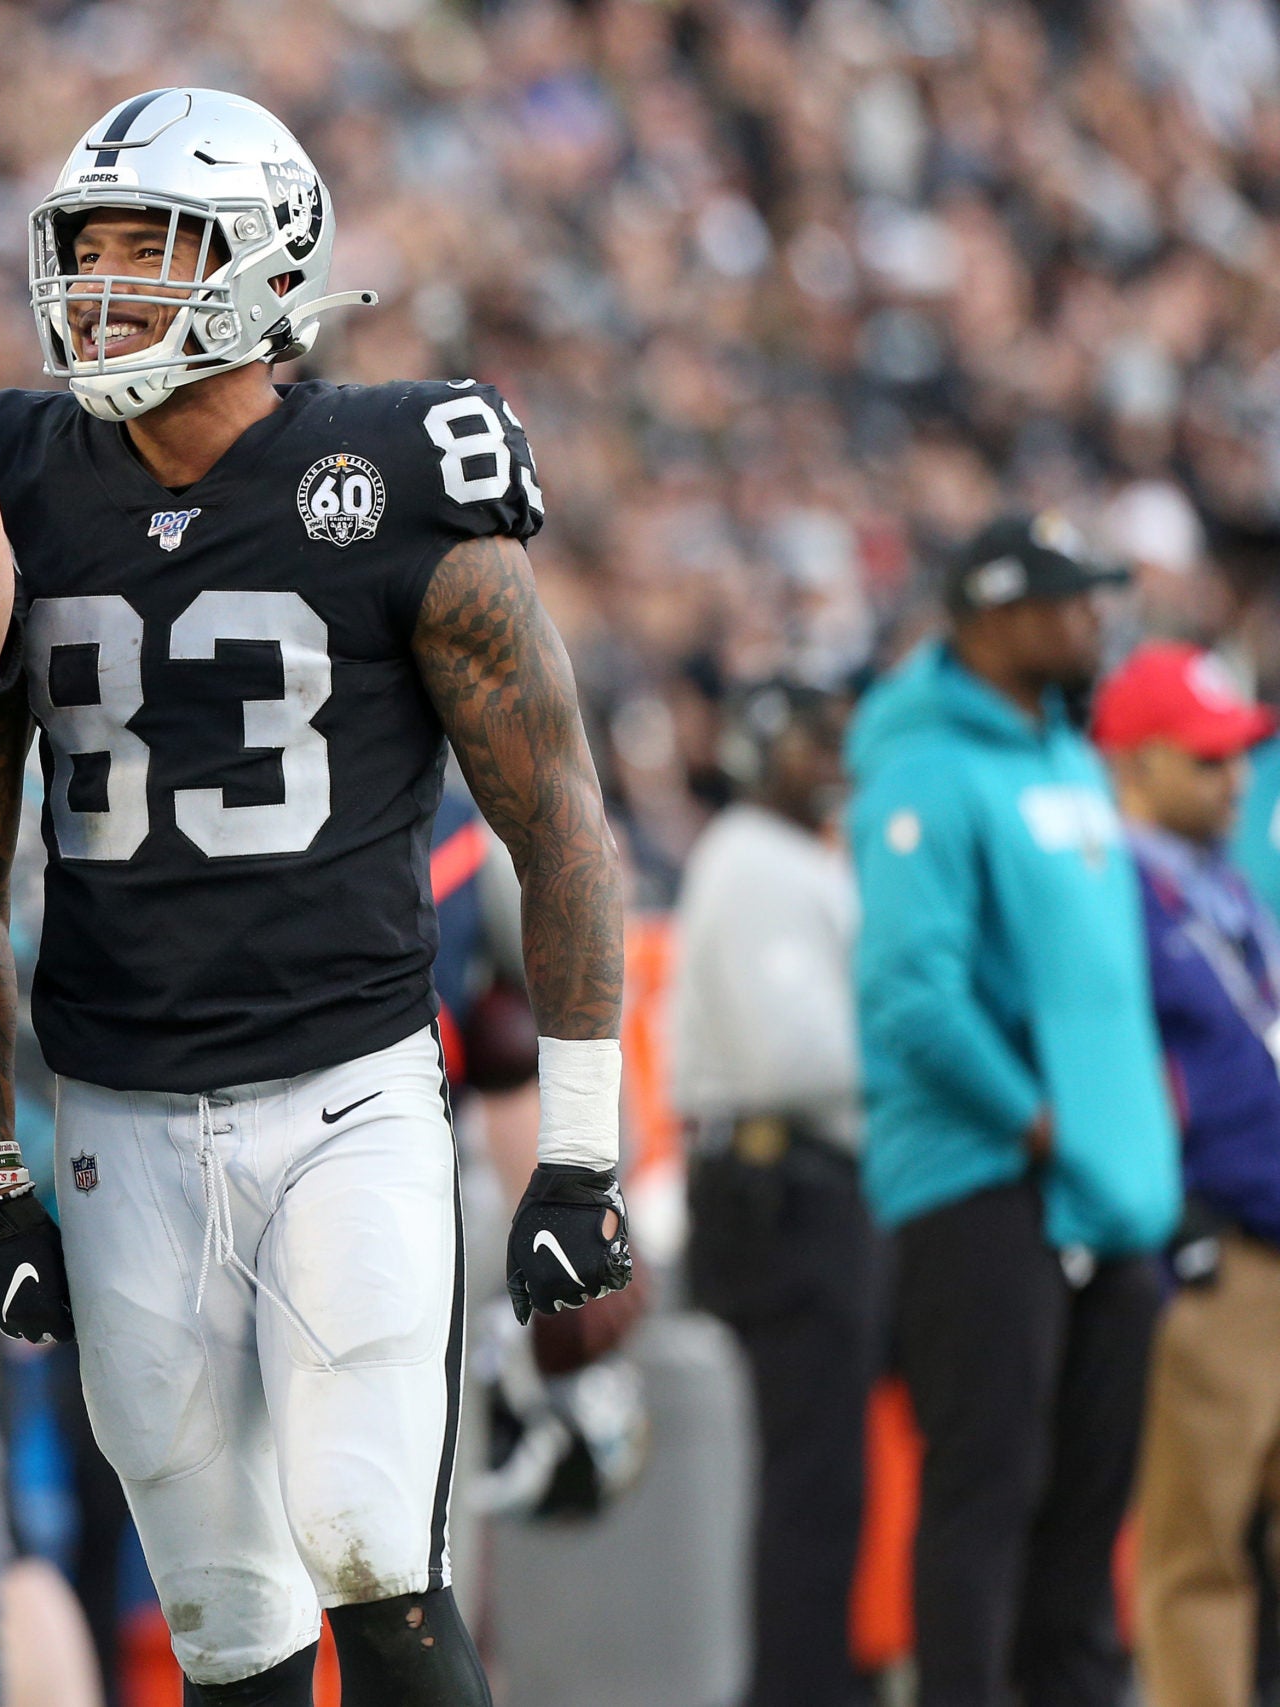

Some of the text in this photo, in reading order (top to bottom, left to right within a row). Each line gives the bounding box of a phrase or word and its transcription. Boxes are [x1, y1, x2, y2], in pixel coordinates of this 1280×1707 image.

[78, 174, 118, 184] RAIDERS
[299, 456, 384, 520] AMERICAN FOOTBALL LEAGUE
[311, 475, 372, 518] 60
[24, 591, 331, 861] 83
[76, 1170, 96, 1187] NFL
